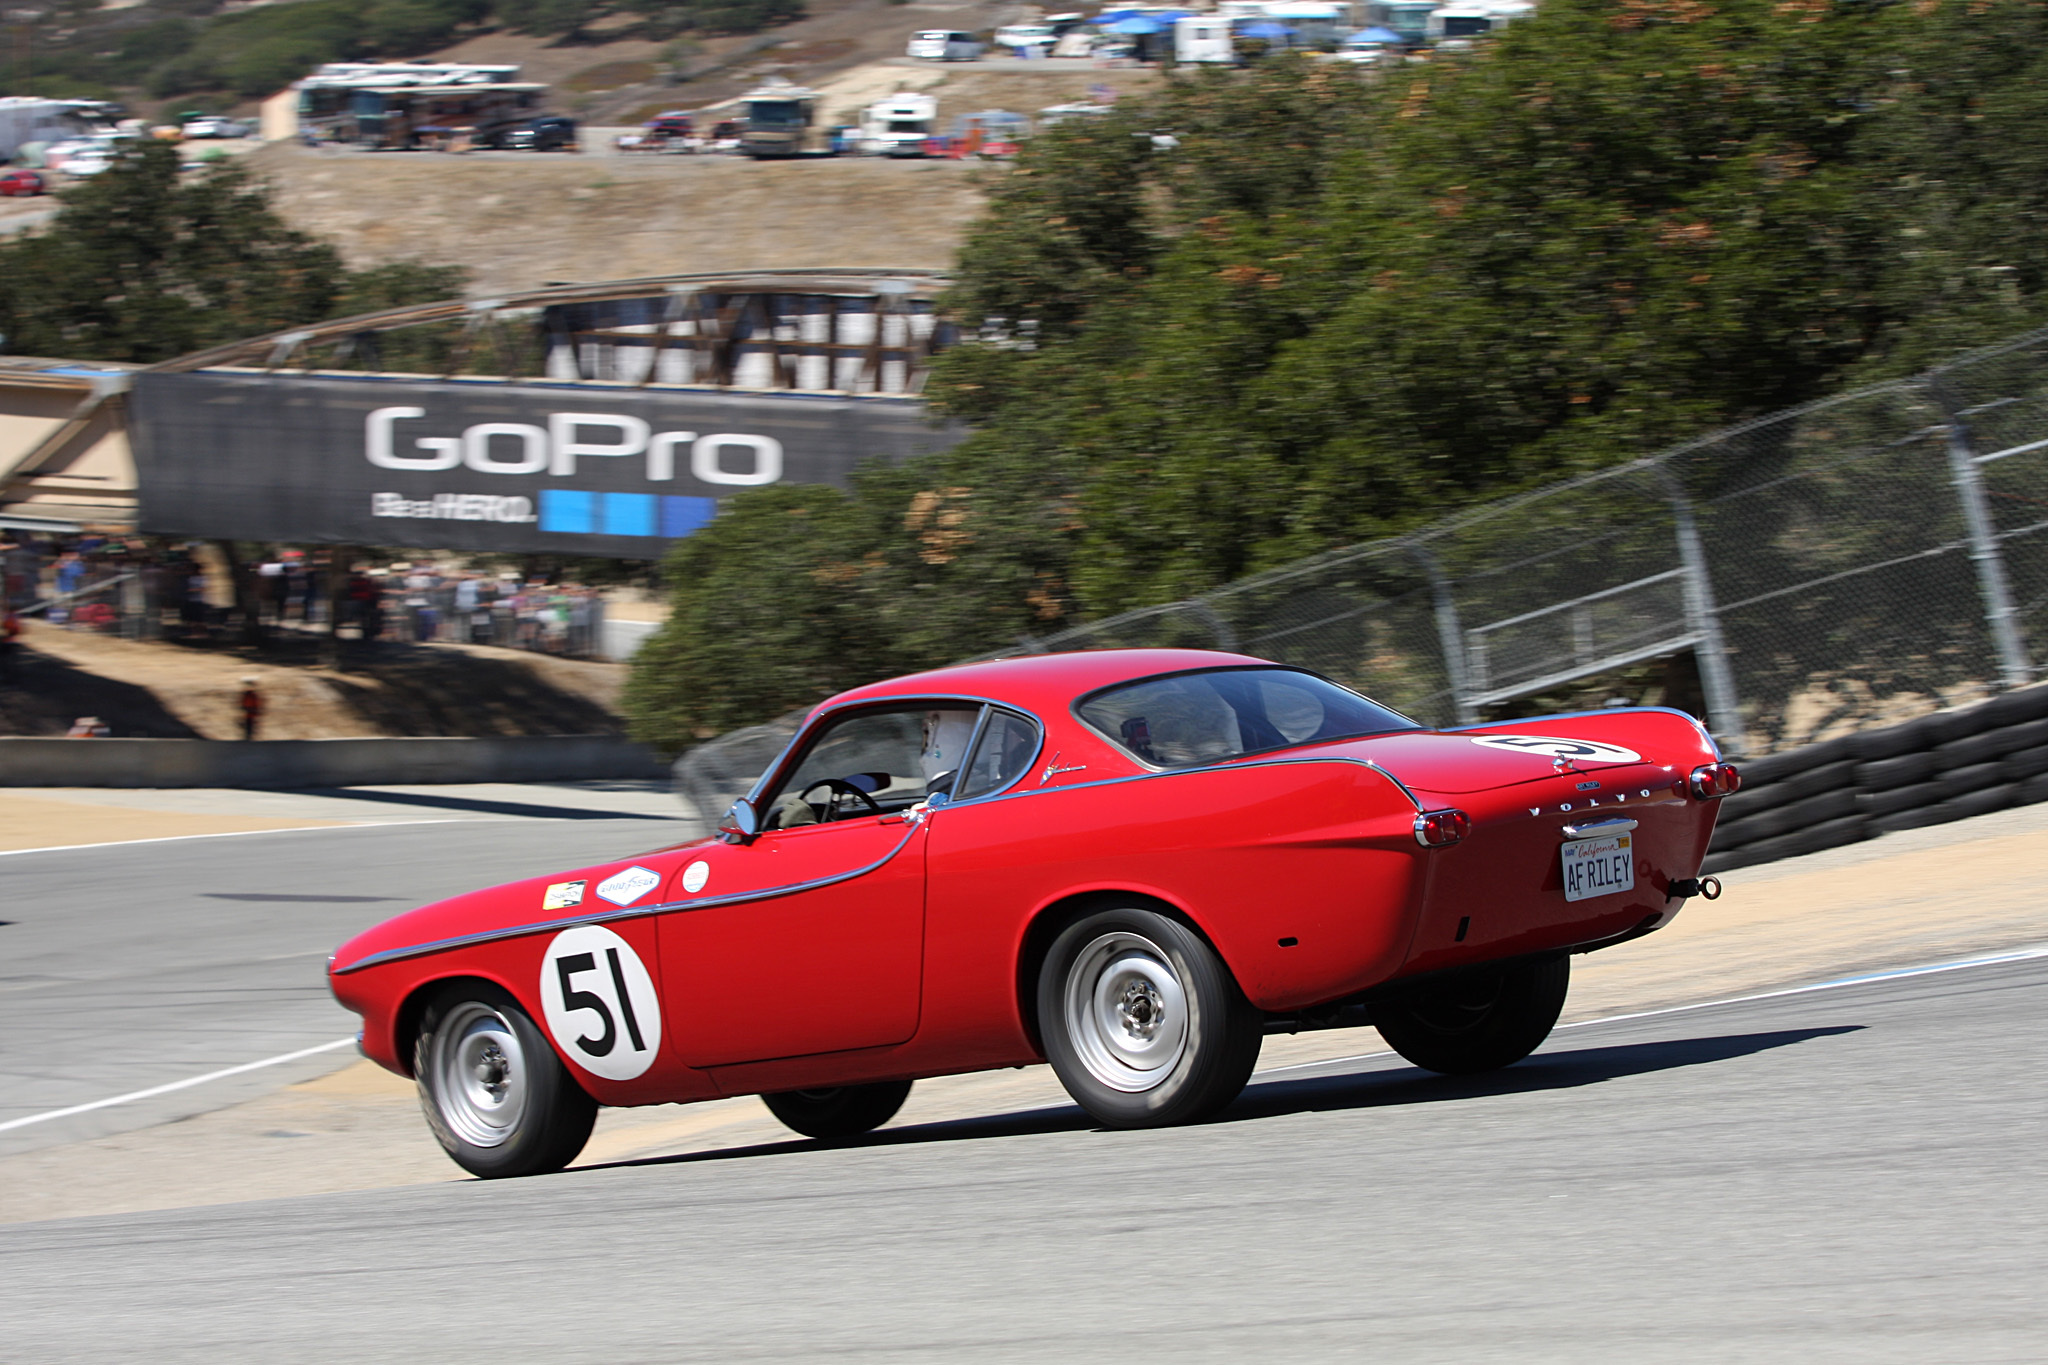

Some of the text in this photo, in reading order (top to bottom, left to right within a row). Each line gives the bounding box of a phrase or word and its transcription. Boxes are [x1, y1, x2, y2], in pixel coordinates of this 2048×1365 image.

[365, 406, 783, 486] GoPro
[1529, 789, 1650, 816] VOLVO
[1578, 842, 1619, 858] California
[1568, 854, 1630, 892] AF RILEY
[555, 947, 647, 1058] 51
